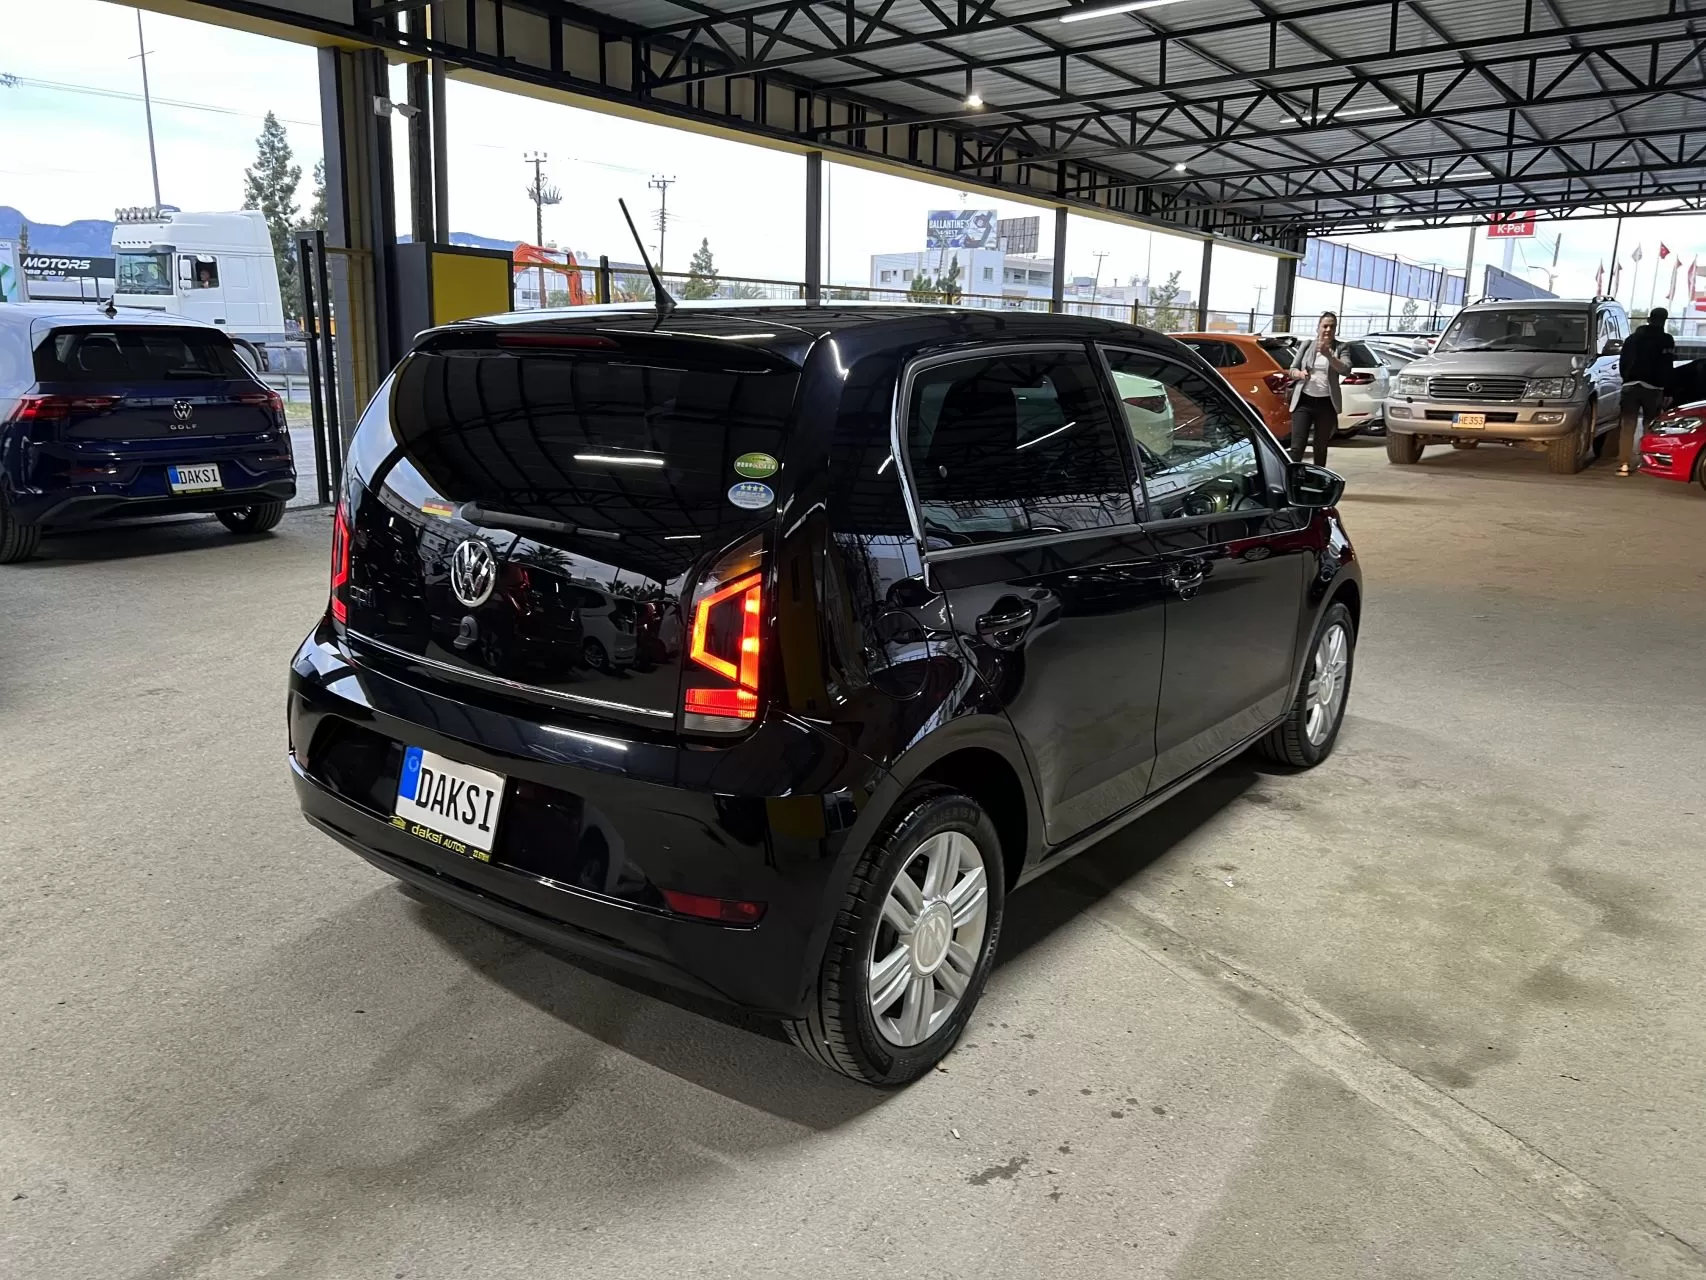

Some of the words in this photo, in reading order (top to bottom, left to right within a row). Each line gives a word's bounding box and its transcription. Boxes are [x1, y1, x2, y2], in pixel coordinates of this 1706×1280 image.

[1497, 223, 1525, 234] K-Pet
[23, 257, 91, 270] MOTORS
[179, 468, 218, 485] DAKSI
[415, 767, 495, 833] DAKSI
[411, 824, 443, 845] daksi
[443, 838, 467, 854] AUTOS
